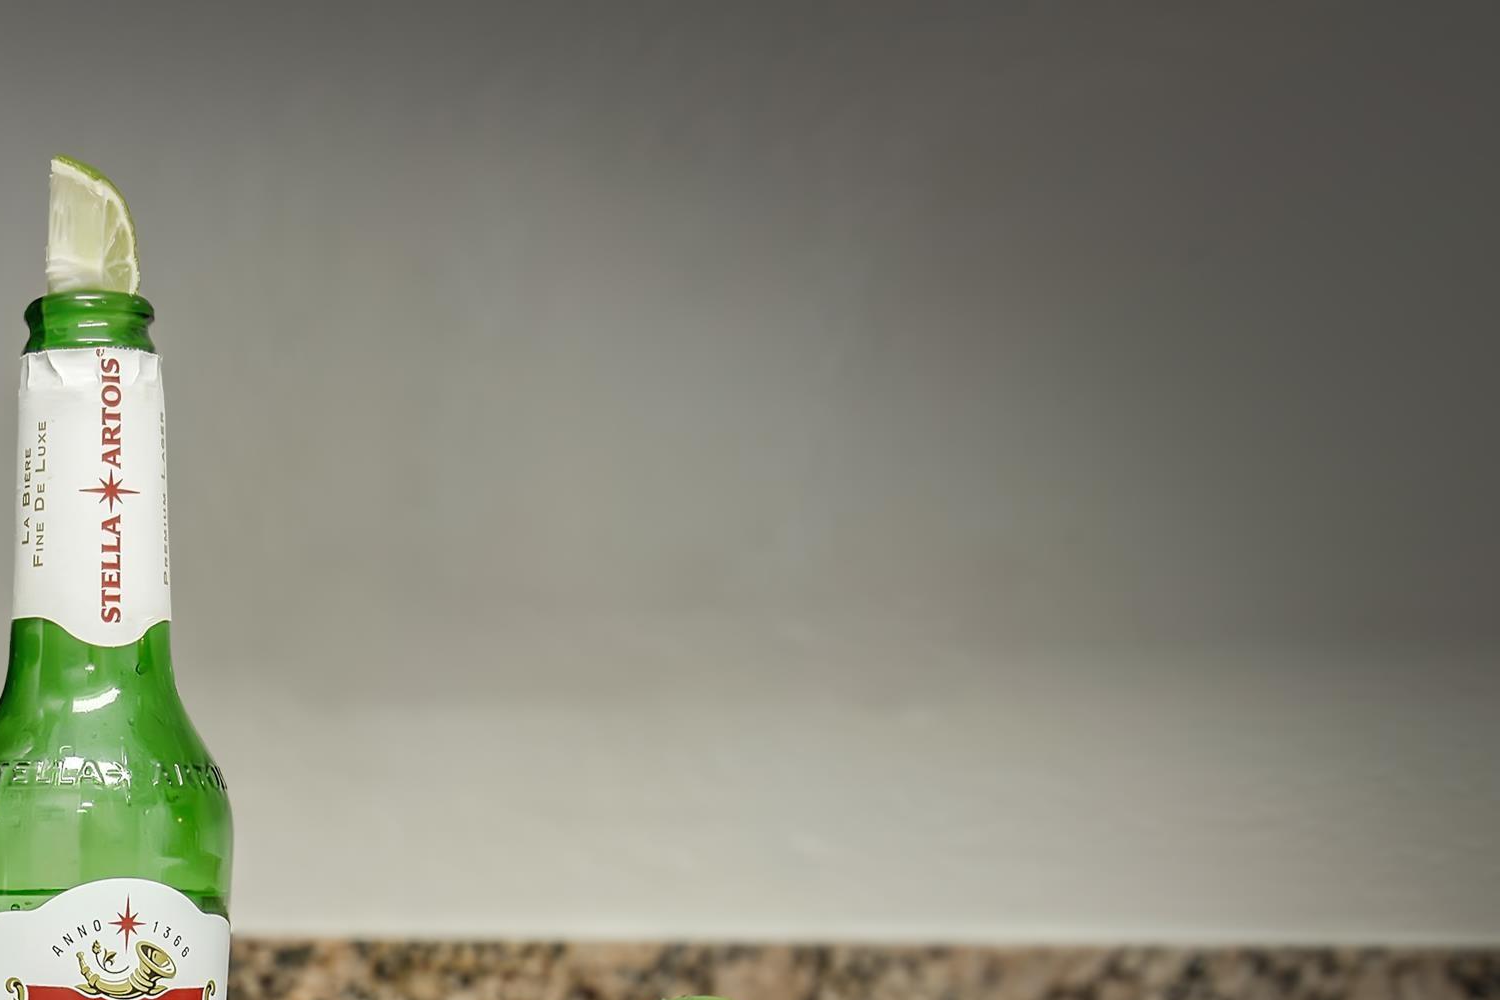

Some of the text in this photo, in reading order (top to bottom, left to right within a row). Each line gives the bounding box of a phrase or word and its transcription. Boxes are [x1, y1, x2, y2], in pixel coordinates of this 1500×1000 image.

[33, 421, 47, 567] FINE DE LUXE
[101, 358, 122, 623] STELLA ARTOIS
[52, 919, 190, 958] ANNO 1366
